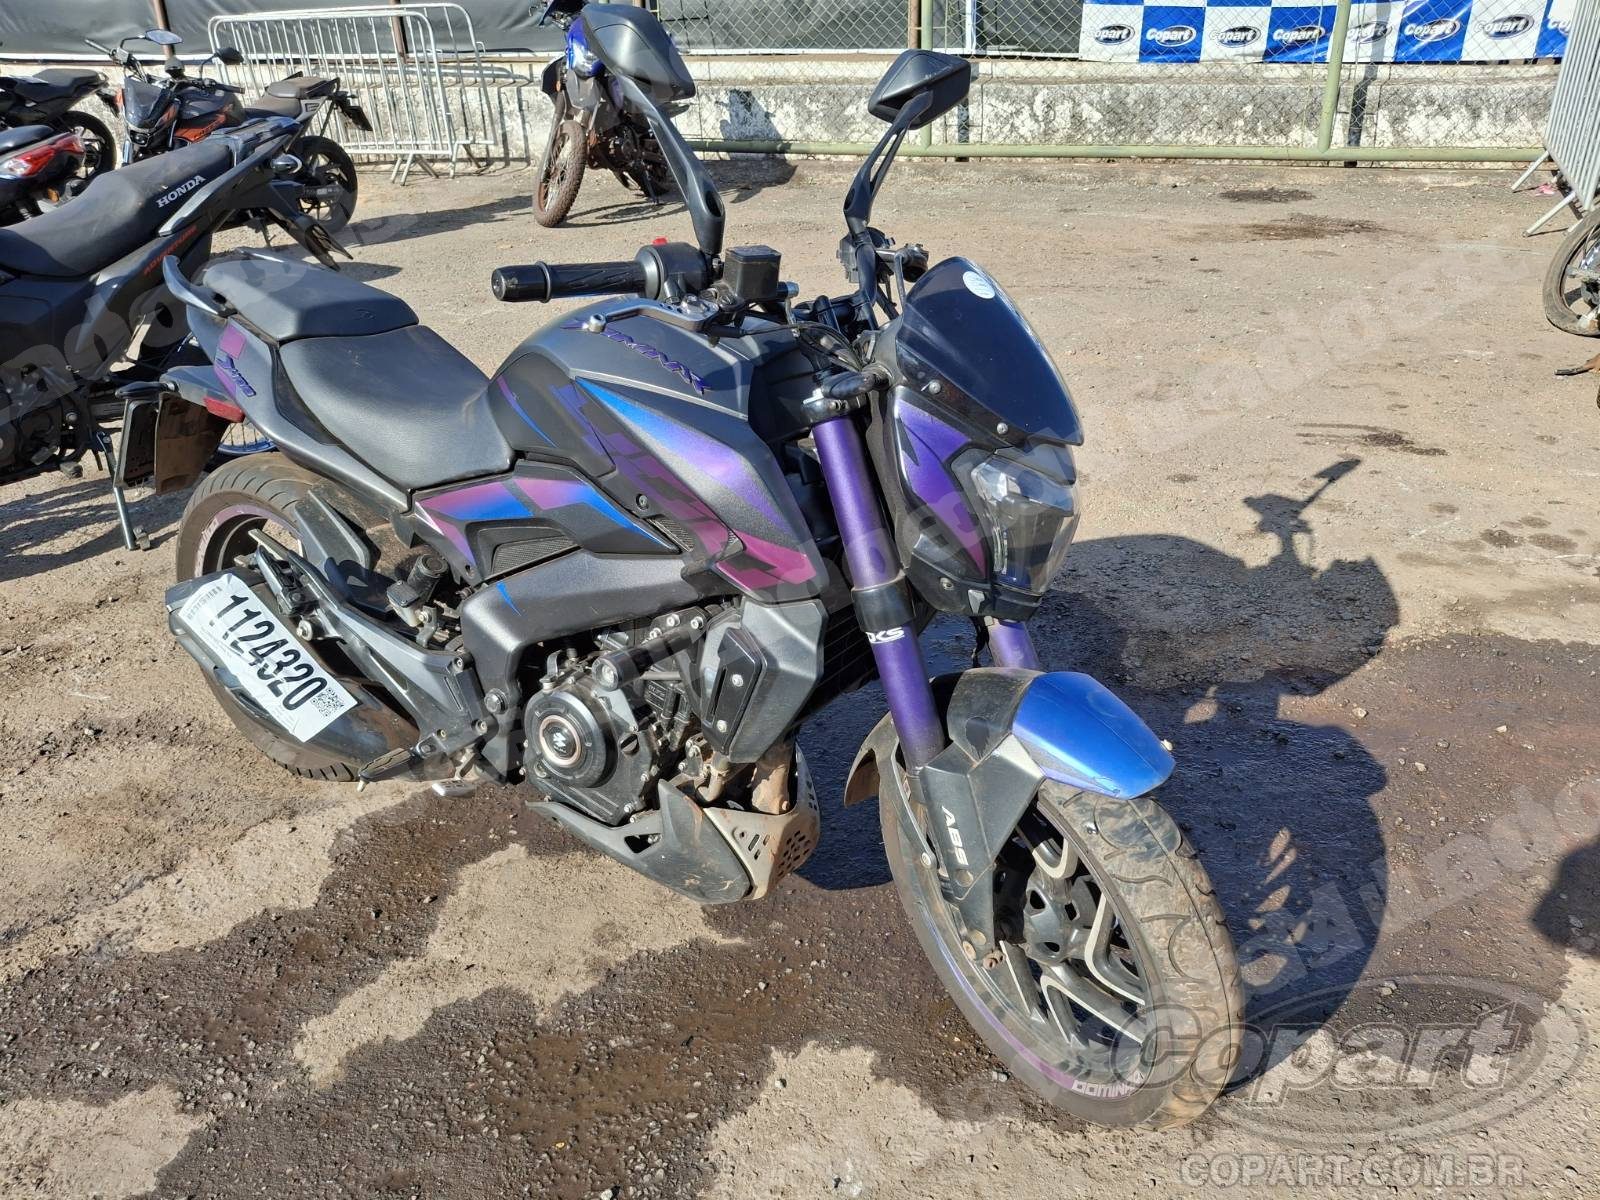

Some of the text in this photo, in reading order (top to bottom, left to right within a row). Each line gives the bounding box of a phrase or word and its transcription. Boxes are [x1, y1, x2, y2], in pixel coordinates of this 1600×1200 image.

[1083, 28, 1130, 41] Copart
[1146, 28, 1191, 42] Copart
[1273, 27, 1320, 42] Copart
[1404, 22, 1454, 37] Copart
[1474, 19, 1526, 36] Copart
[1210, 29, 1256, 43] Copart
[156, 174, 206, 208] HONDA
[209, 594, 328, 711] 1124320
[942, 805, 969, 866] ABS
